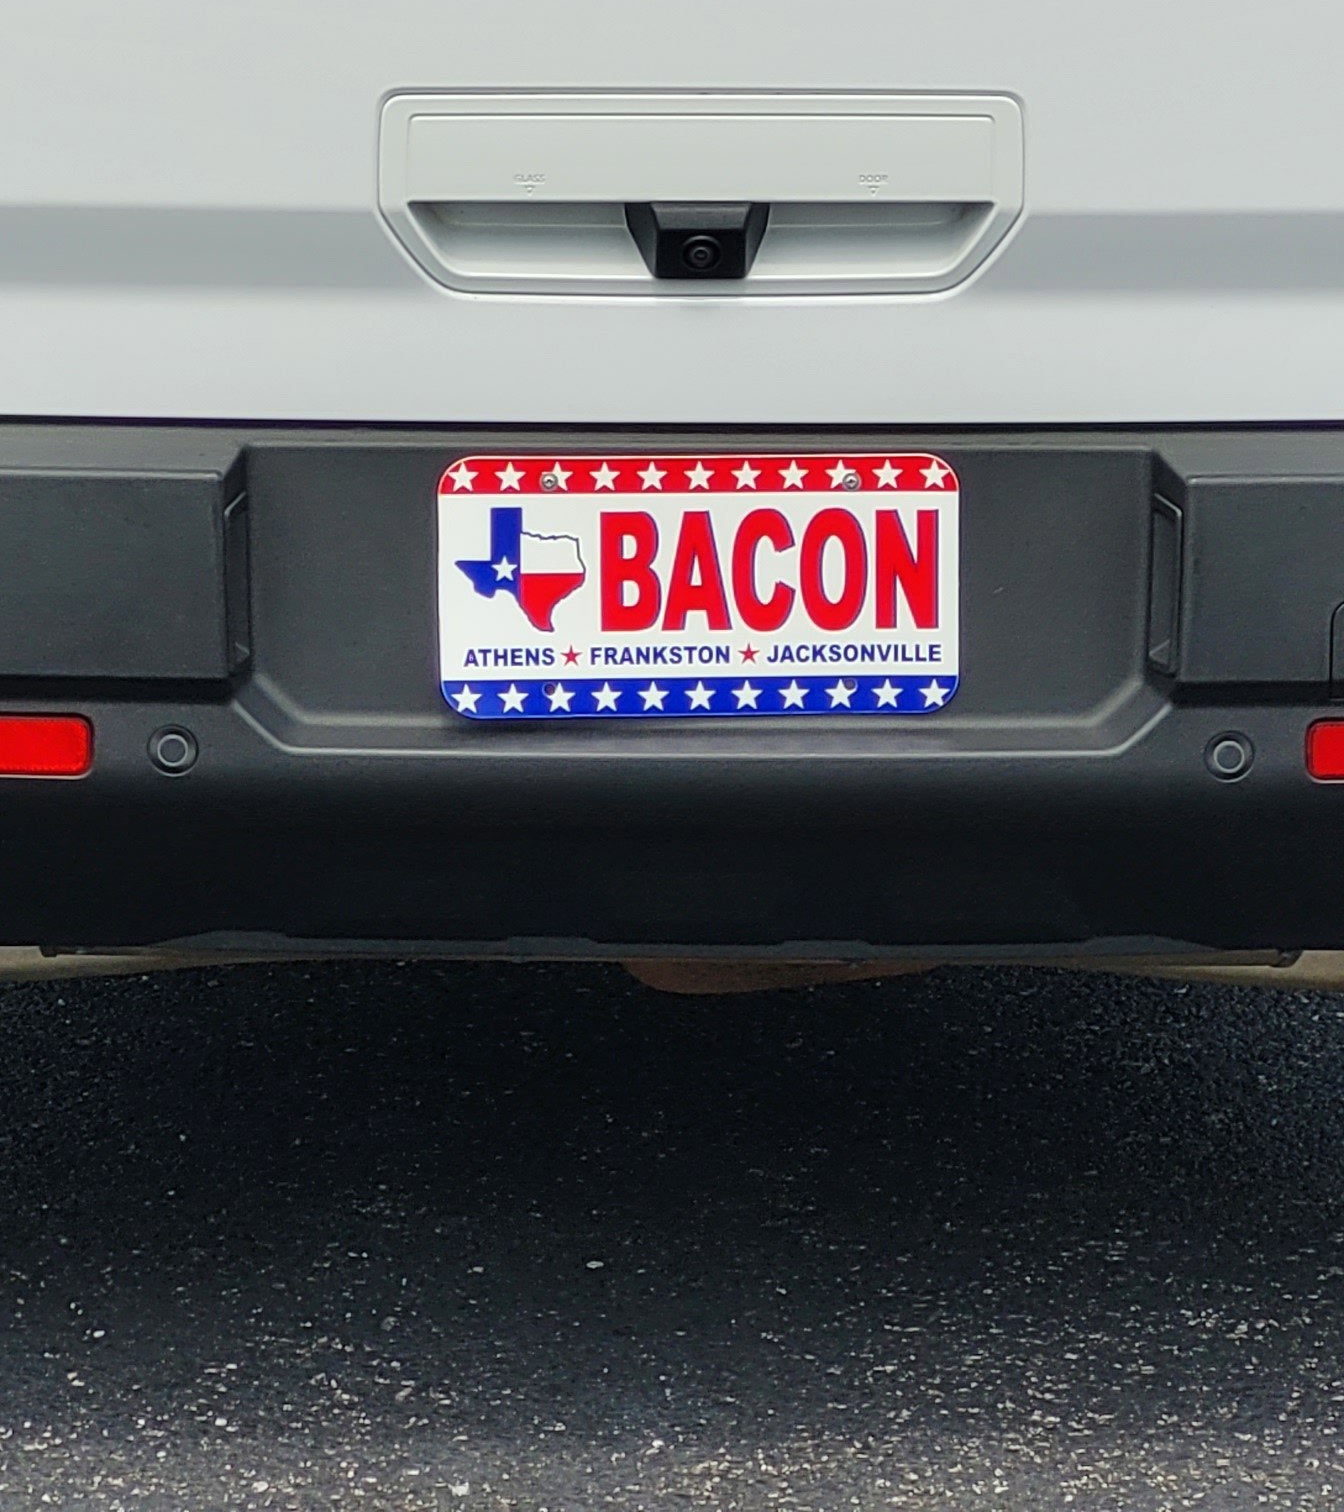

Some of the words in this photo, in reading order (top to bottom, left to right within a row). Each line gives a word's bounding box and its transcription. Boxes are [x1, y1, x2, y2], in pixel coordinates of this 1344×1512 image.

[599, 508, 940, 632] BACON
[462, 645, 556, 667] ATHENS
[589, 645, 731, 666] FRANKSTON
[766, 643, 942, 664] JACKSONVILLE
